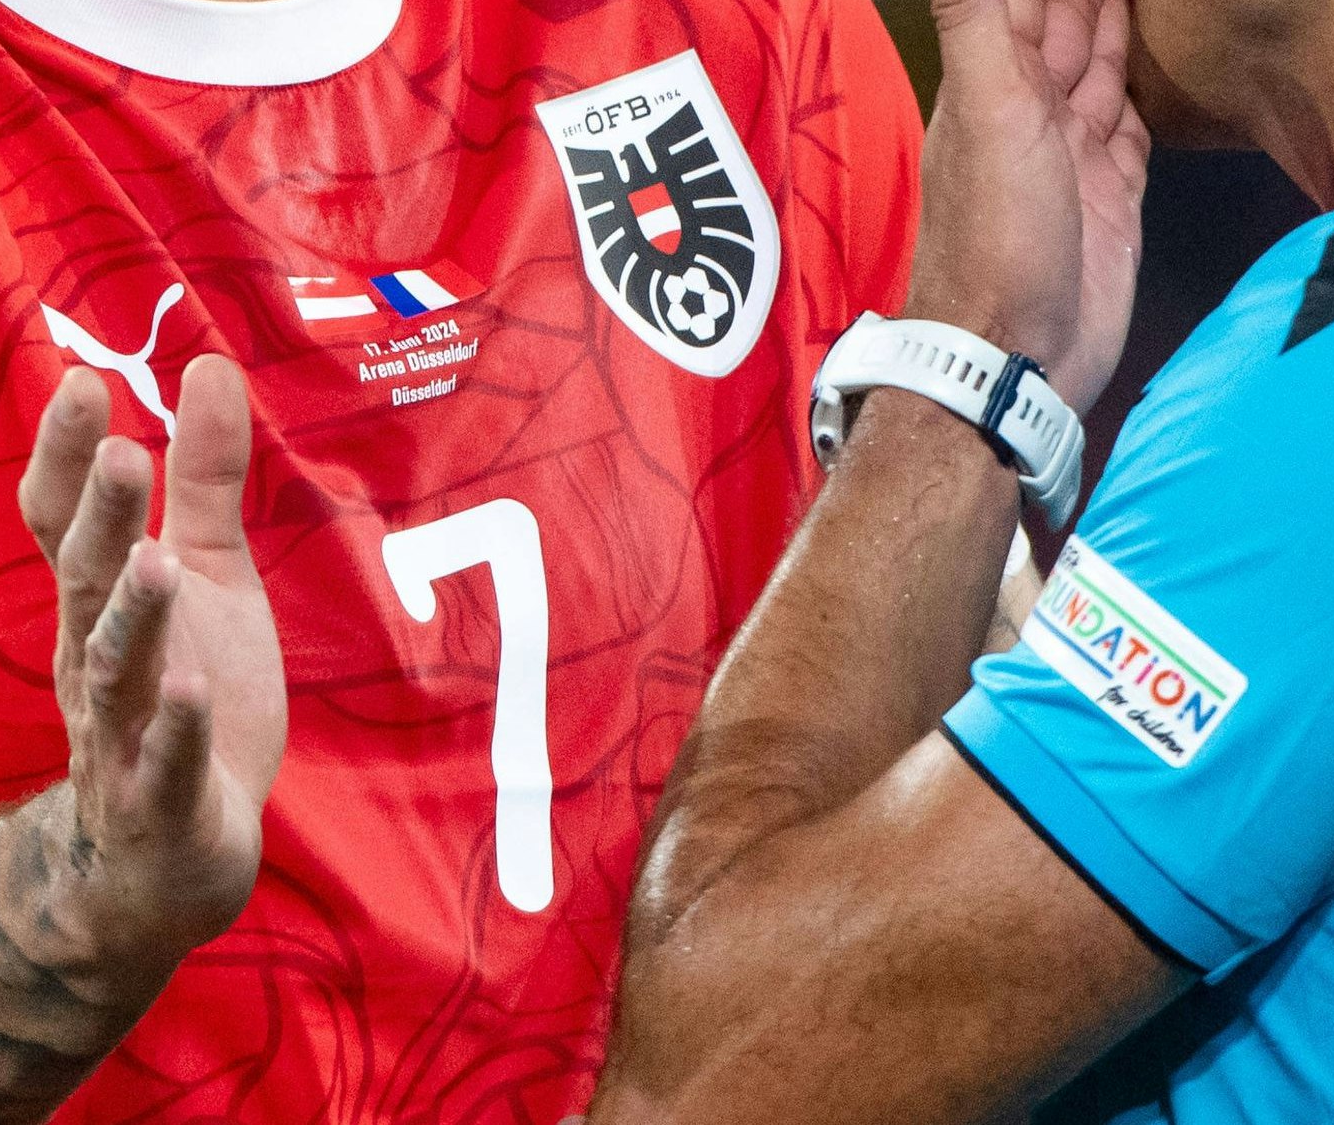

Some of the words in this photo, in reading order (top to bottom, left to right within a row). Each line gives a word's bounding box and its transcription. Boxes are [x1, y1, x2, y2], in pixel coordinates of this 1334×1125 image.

[562, 123, 583, 138] SEIT
[584, 95, 652, 135] ÖFB
[653, 89, 682, 105] 1904
[388, 335, 423, 353] Juni
[420, 319, 460, 344] 2024
[358, 360, 407, 383] Arena
[405, 337, 479, 372] Düsseldorf
[391, 373, 458, 407] Düsseldorf
[380, 497, 555, 913] 7
[1095, 685, 1129, 706] for
[1126, 709, 1185, 758] children
